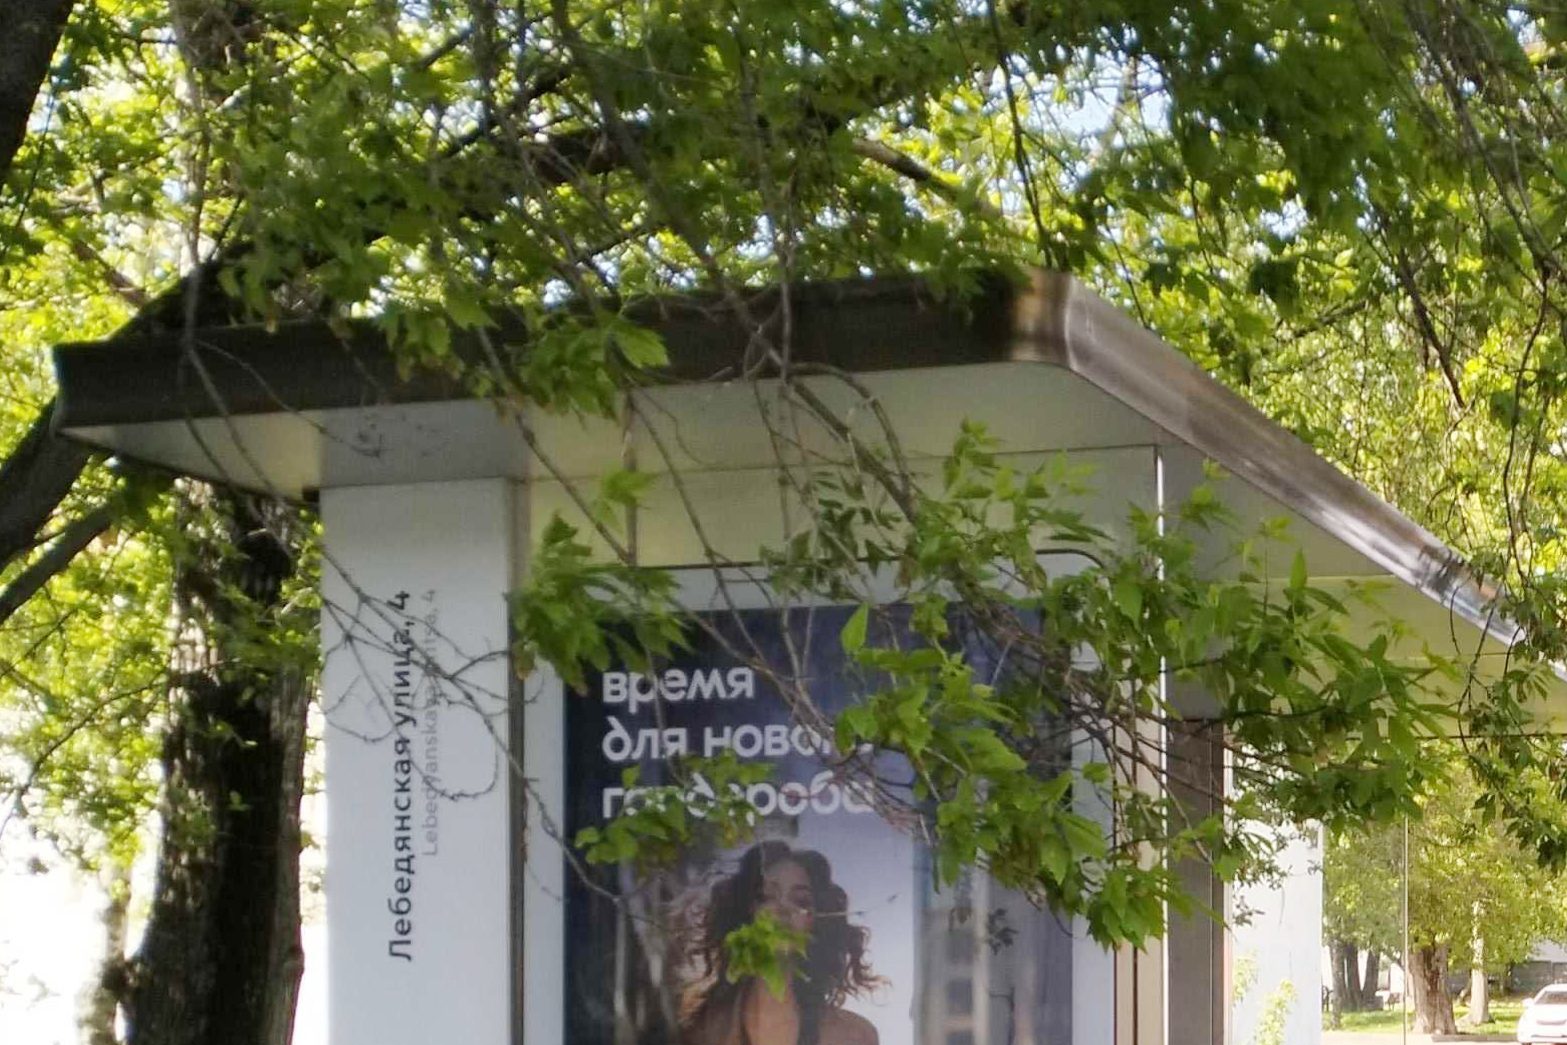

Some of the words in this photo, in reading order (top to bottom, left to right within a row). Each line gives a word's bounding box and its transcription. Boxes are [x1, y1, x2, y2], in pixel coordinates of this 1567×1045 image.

[386, 590, 410, 610] 4
[393, 621, 417, 727] улица,
[602, 666, 755, 713] время
[602, 716, 687, 761] для
[703, 724, 874, 758] ново
[388, 737, 415, 961] Лебедянская
